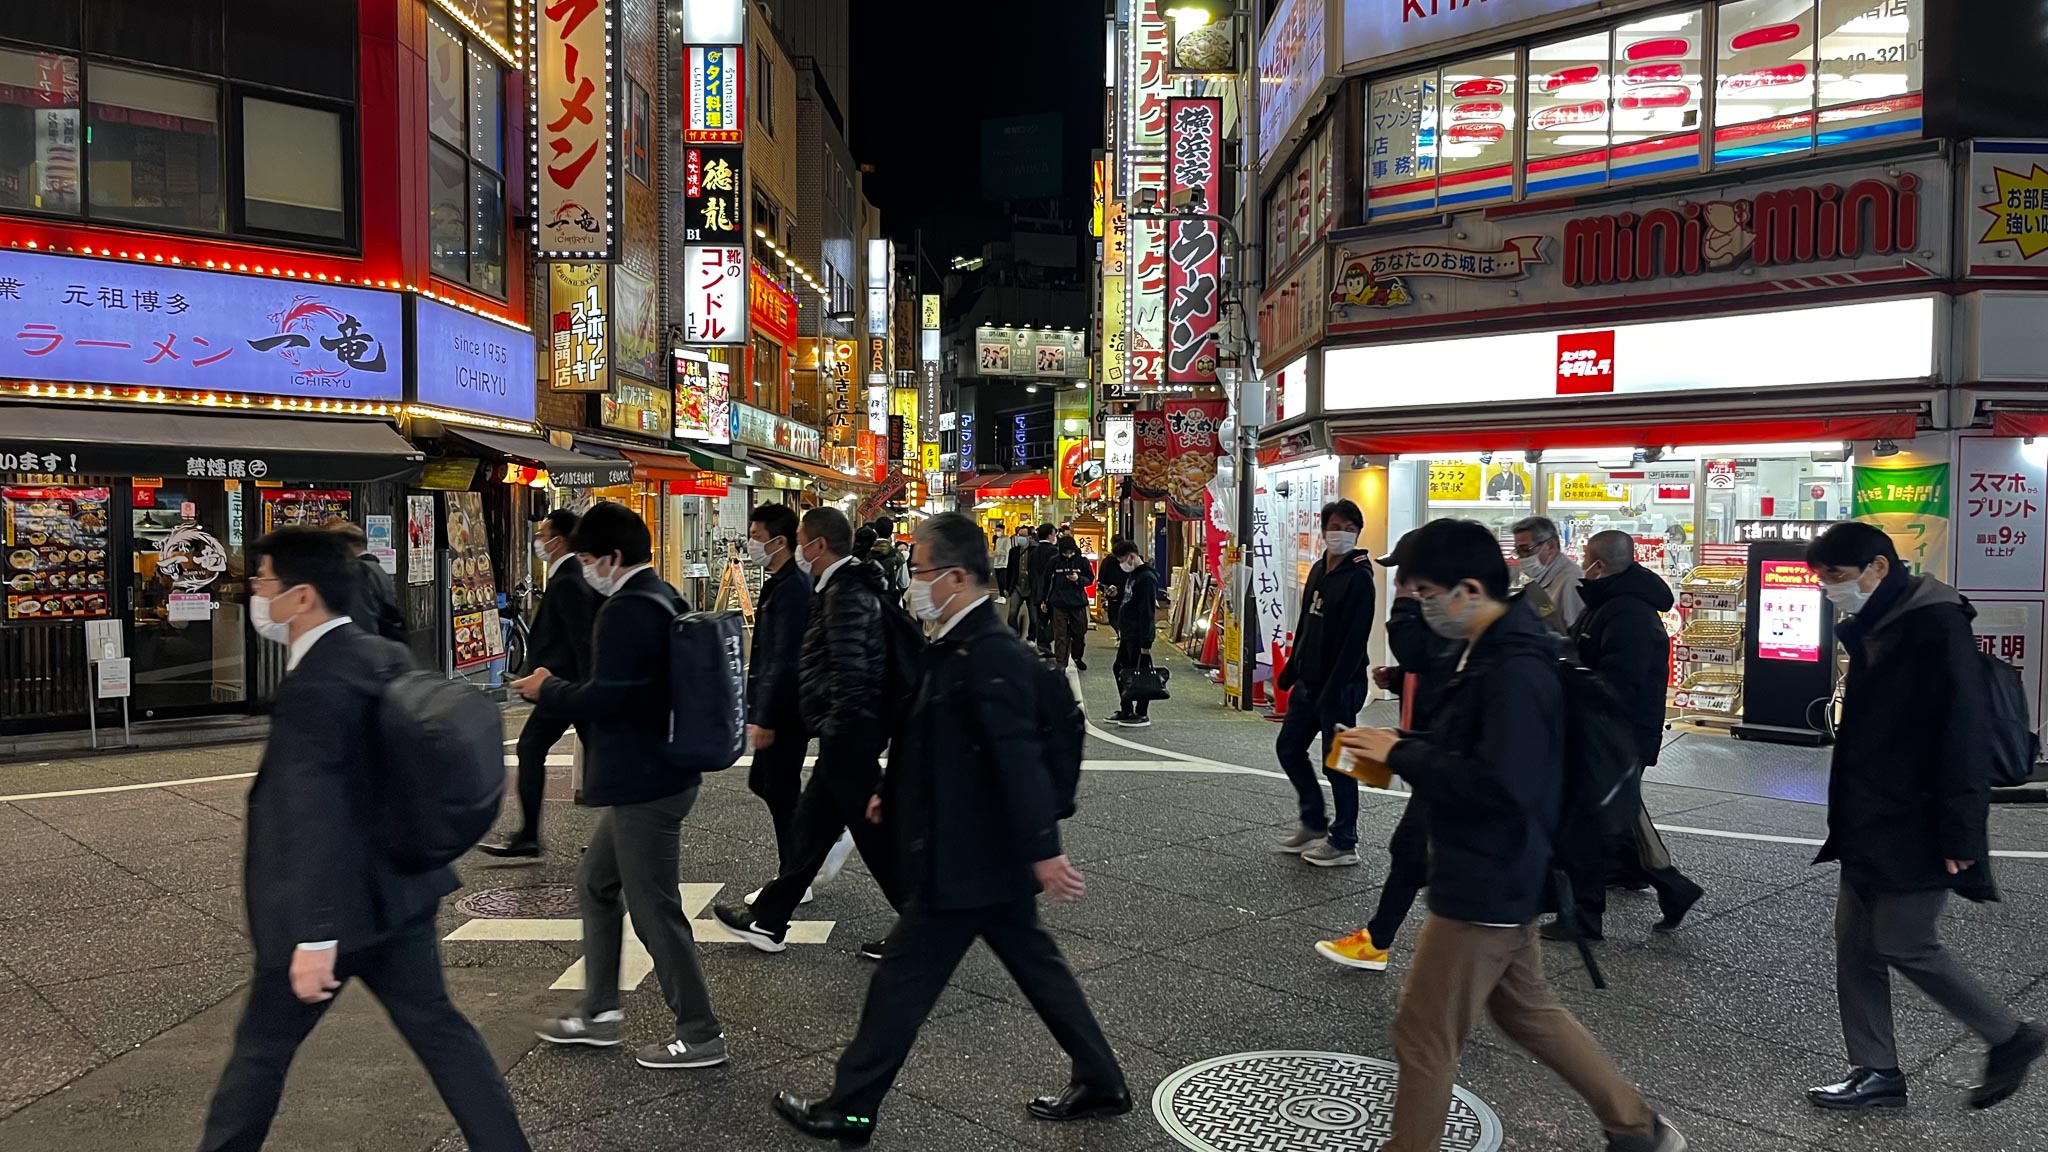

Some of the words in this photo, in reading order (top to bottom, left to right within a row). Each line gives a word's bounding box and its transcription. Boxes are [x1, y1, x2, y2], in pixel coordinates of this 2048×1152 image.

[706, 64, 721, 127] タイ料理
[1372, 155, 1435, 178] 事務所
[554, 235, 594, 244] ICHIRYU
[686, 228, 702, 240] B1
[1562, 202, 1701, 287] mini
[1754, 173, 1918, 267] mini
[727, 249, 741, 278] 靴の
[64, 284, 192, 316] 元祖博多
[700, 248, 725, 341] コンドル
[586, 284, 607, 382] 1ポンド
[687, 311, 697, 340] 1F
[17, 324, 234, 368] ラーメン
[245, 313, 388, 373] 一竜
[454, 334, 480, 357] since
[482, 340, 507, 364] 1955
[553, 311, 571, 388] 肉専門店
[571, 301, 588, 384] ステーキ
[872, 339, 884, 372] BAR
[1560, 349, 1597, 361] カメラの
[290, 374, 352, 389] ICHIRYU
[455, 366, 507, 397] ICHIRYU
[1132, 355, 1163, 382] 24
[1558, 358, 1612, 378] キタムラ
[835, 360, 852, 427] やきとん
[961, 413, 974, 471] アラジン
[186, 456, 247, 478] 禁煙席
[1429, 470, 1466, 480] ラクラク
[1967, 498, 2038, 519] プリント
[1984, 546, 2016, 558] 仕上げ
[1764, 573, 1802, 584] iPhone
[1804, 574, 1819, 584] 14
